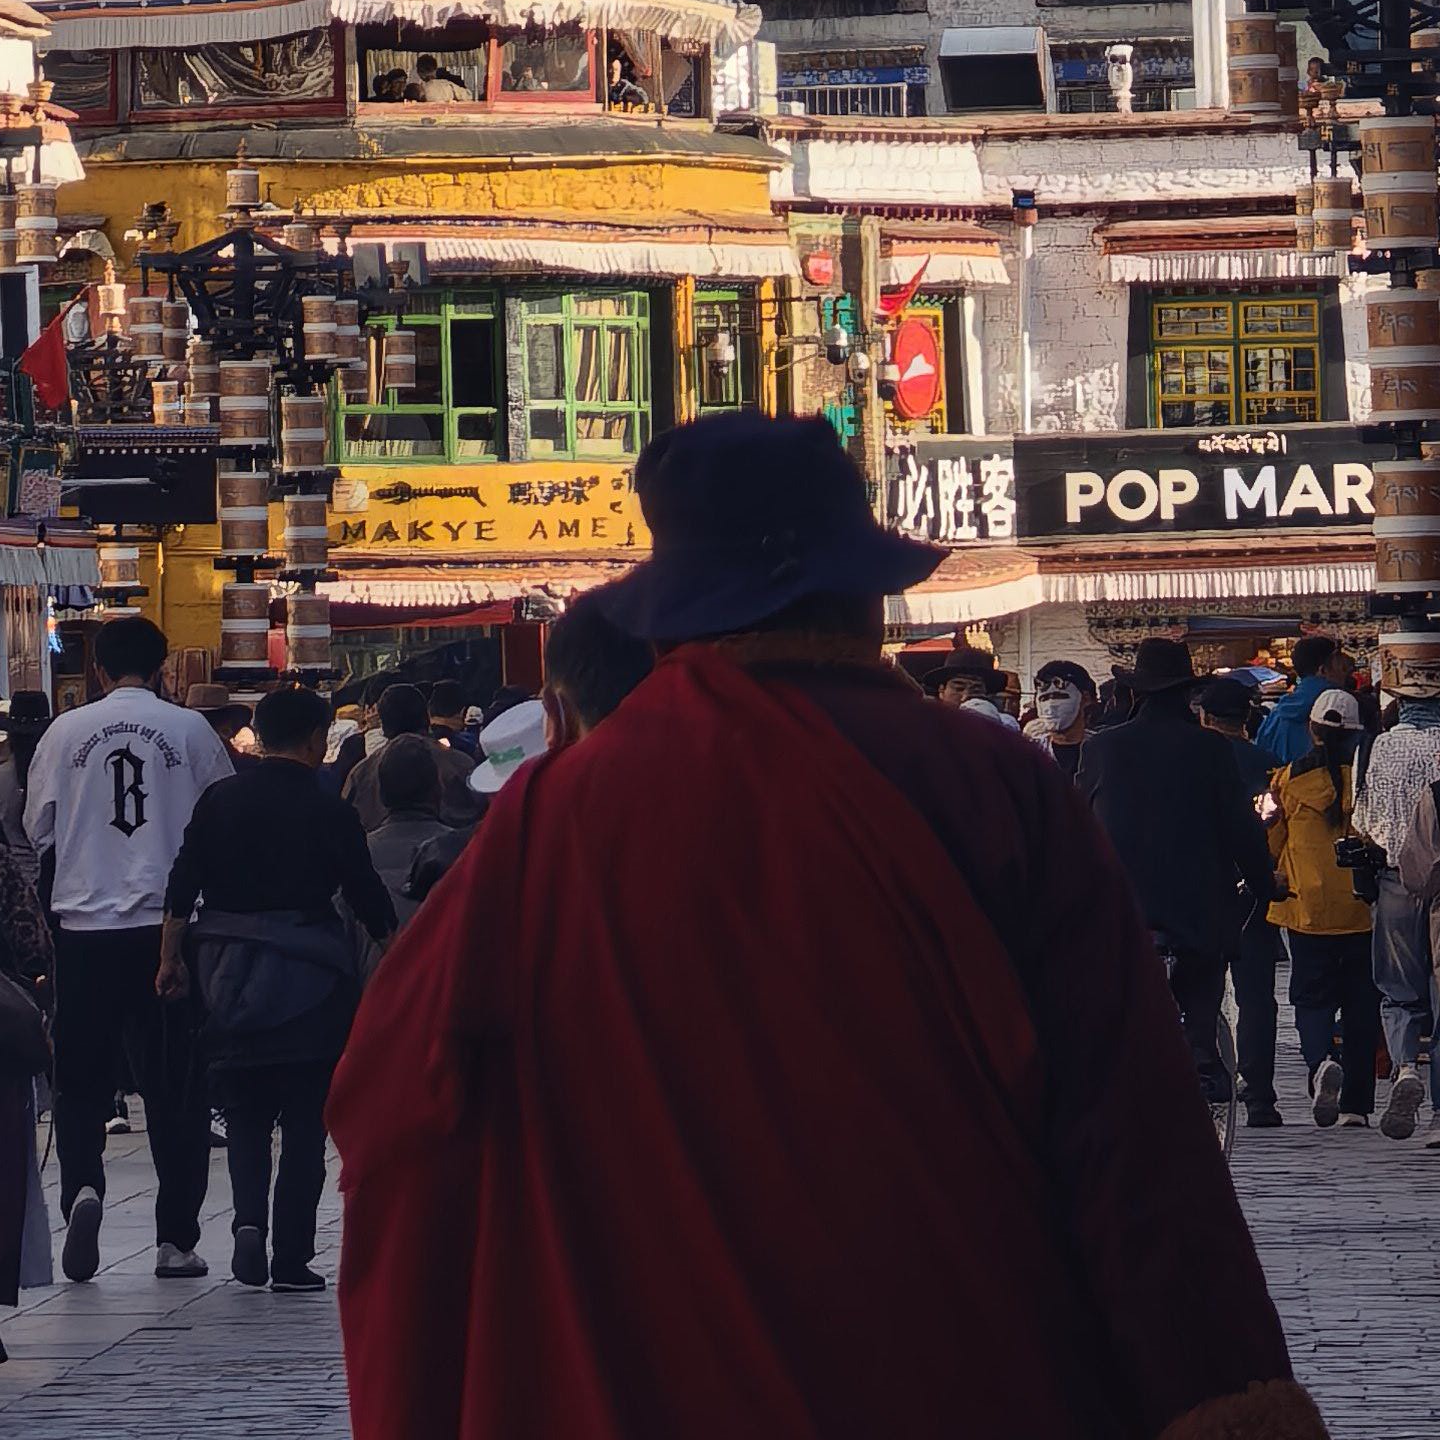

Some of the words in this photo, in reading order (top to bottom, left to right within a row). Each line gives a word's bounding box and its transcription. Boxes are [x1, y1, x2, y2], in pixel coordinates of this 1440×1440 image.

[898, 453, 1016, 541] 必胜客
[1065, 469, 1200, 524] POP
[1223, 462, 1376, 520] MAR
[341, 518, 498, 543] MAKYE
[527, 516, 610, 540] AME
